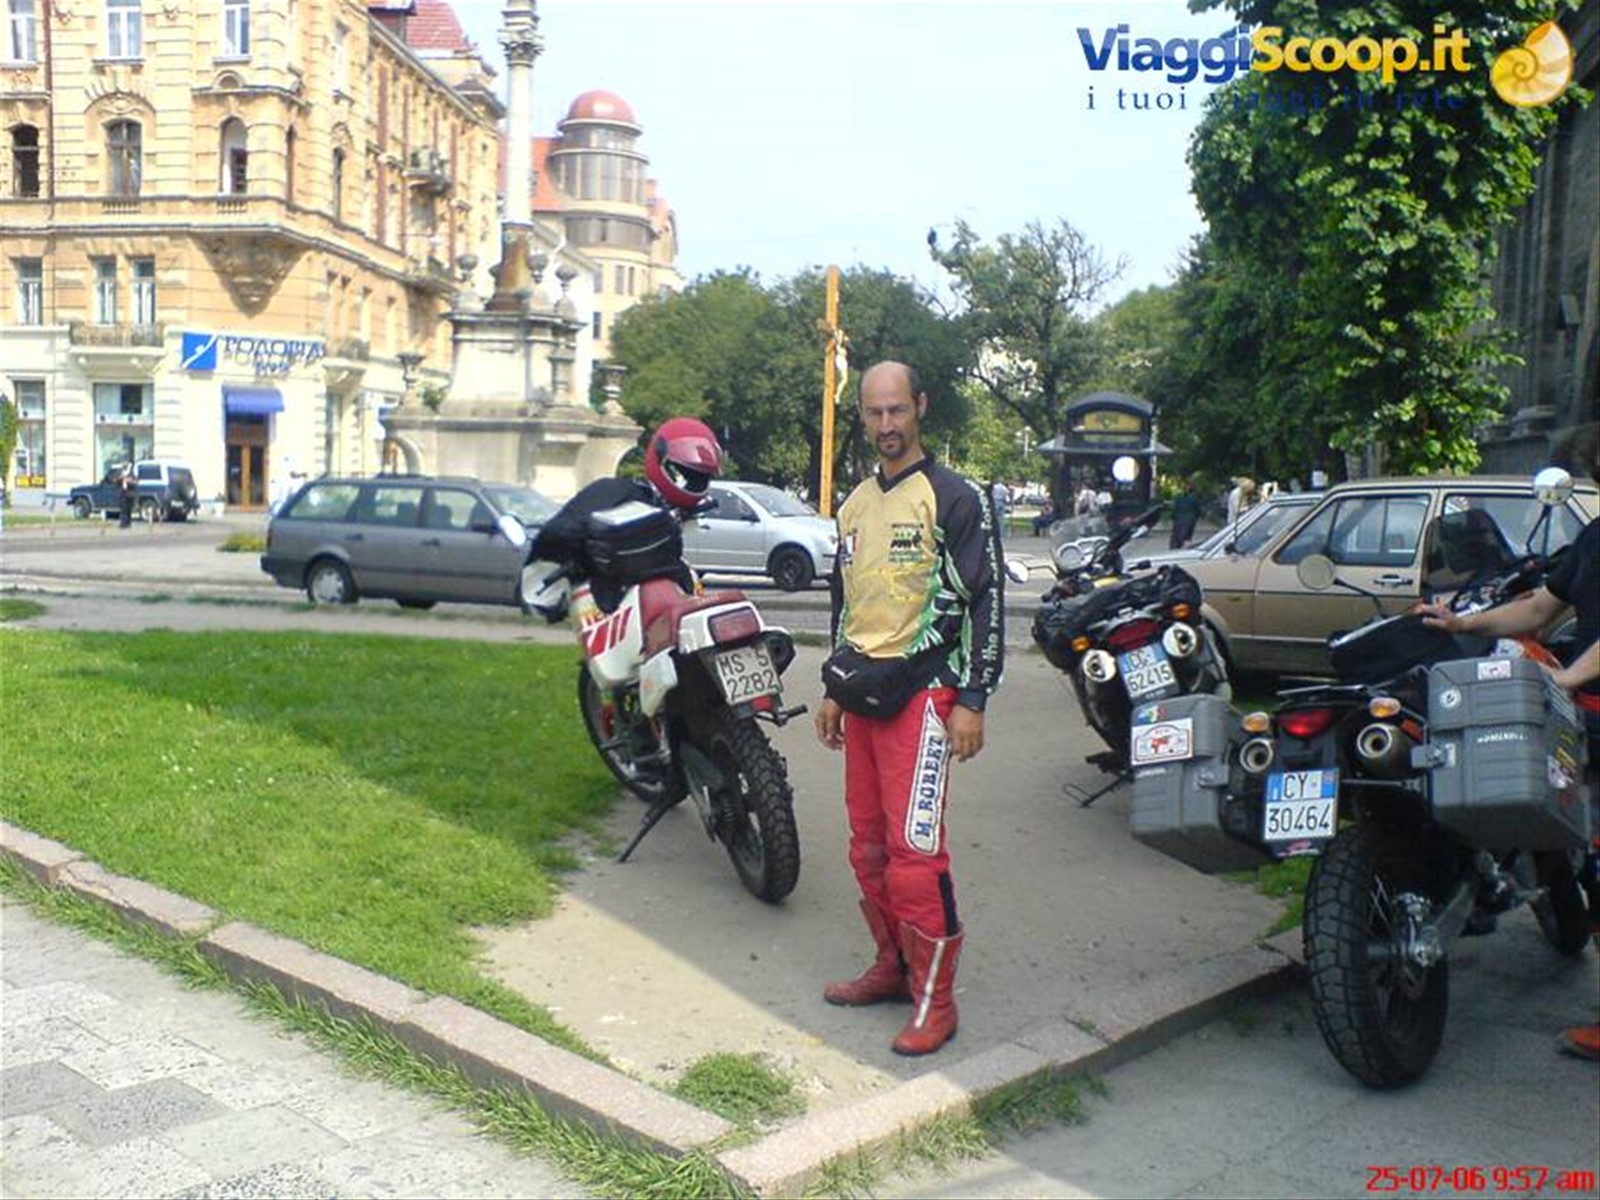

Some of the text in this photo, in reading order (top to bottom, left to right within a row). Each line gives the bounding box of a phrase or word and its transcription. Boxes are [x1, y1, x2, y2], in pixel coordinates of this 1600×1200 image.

[718, 644, 769, 676] MS 5
[727, 669, 777, 702] 2282
[1128, 663, 1171, 692] 62415
[918, 735, 944, 811] ROBERT
[1284, 773, 1308, 798] CY
[1268, 804, 1331, 833] 30464
